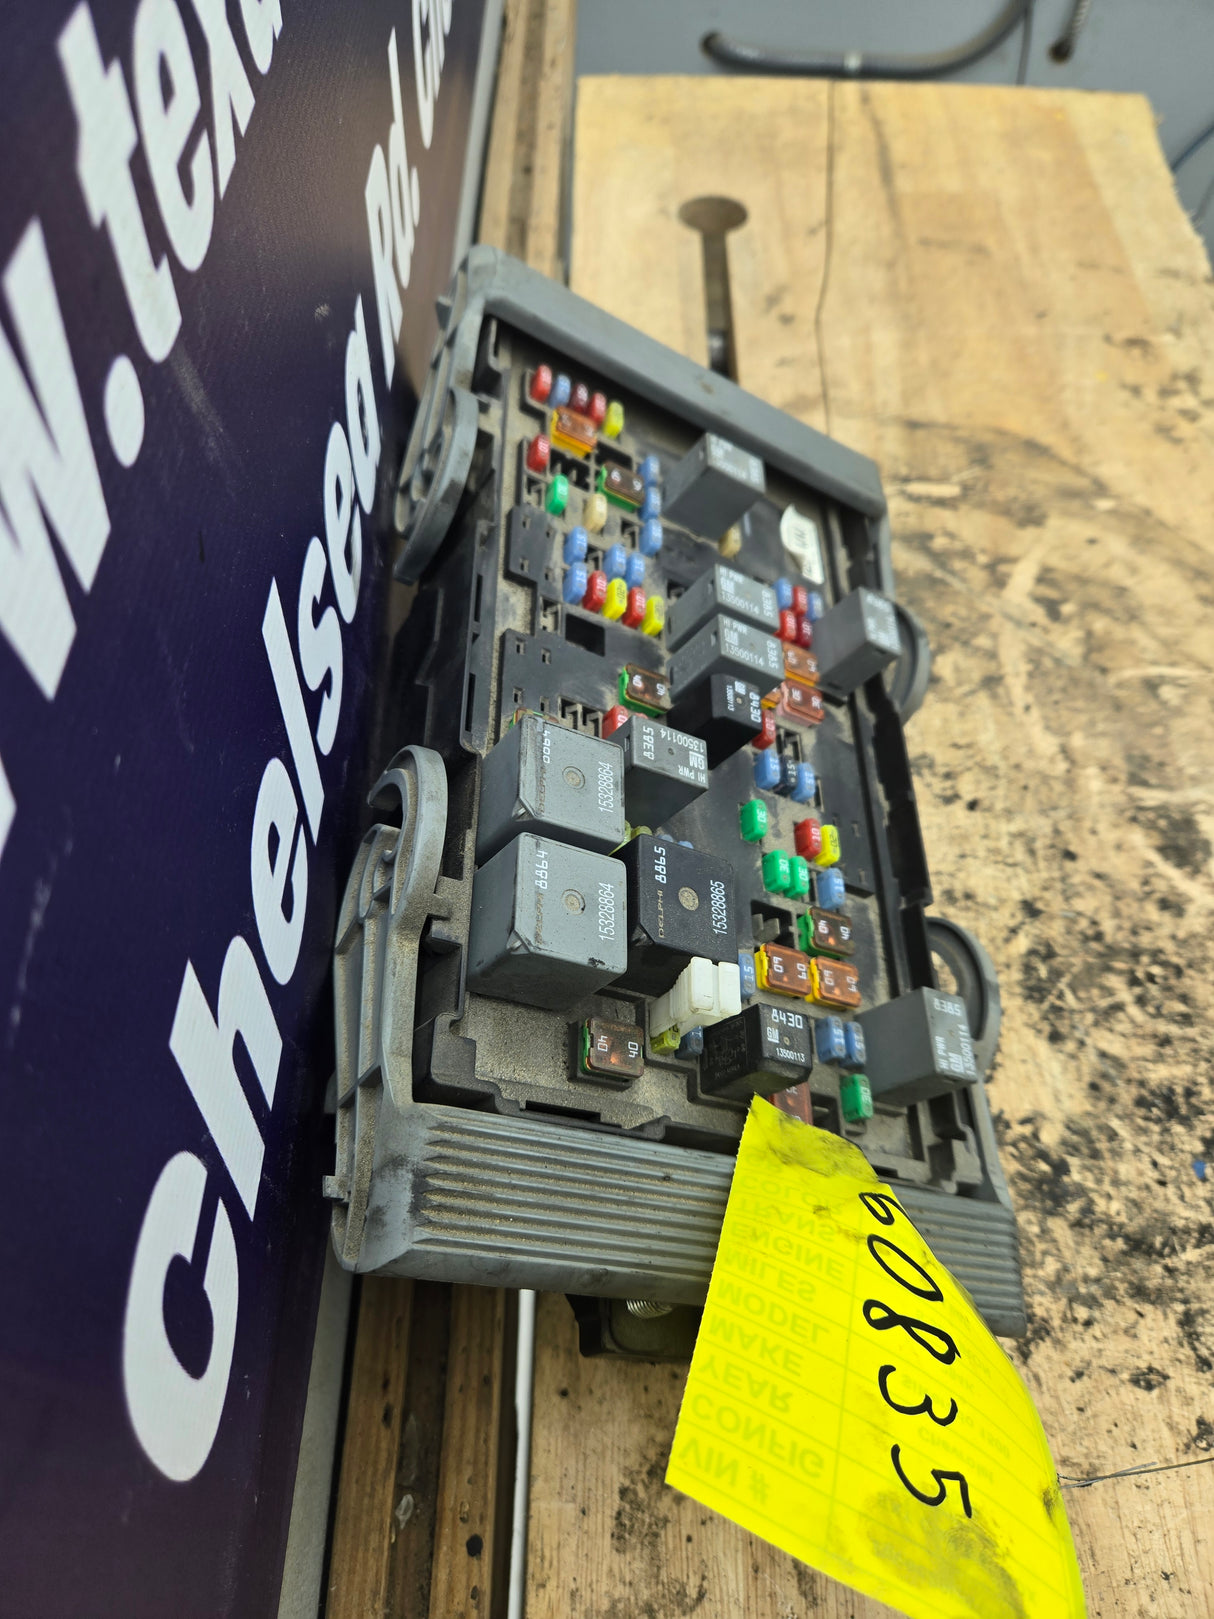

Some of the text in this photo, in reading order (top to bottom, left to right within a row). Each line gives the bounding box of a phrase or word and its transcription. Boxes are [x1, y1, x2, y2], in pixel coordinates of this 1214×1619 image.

[725, 642, 765, 667] 13500114
[660, 728, 705, 752] 13500114
[123, 293, 382, 1482] Chelsea
[364, 25, 420, 390] Rd.
[689, 752, 706, 770] GM
[677, 764, 706, 784] HI PWR
[598, 760, 614, 813] 15328864
[535, 849, 548, 889] 8864
[653, 845, 667, 939] DELPHI 8865
[598, 881, 615, 942] 15328864
[710, 879, 728, 935] 15328865
[818, 919, 830, 935] 40
[840, 926, 852, 940] 40
[743, 965, 754, 982] 15
[772, 956, 785, 974] 60
[796, 962, 808, 980] 60
[823, 969, 835, 986] 60
[771, 1008, 804, 1030] 8430
[597, 1035, 608, 1053] 40
[766, 1026, 780, 1044] GM
[833, 1027, 845, 1046] 15
[627, 1041, 639, 1059] 40
[775, 1047, 806, 1063] 13500113
[959, 1024, 977, 1076] 13500114
[857, 1191, 974, 1519] 60835
